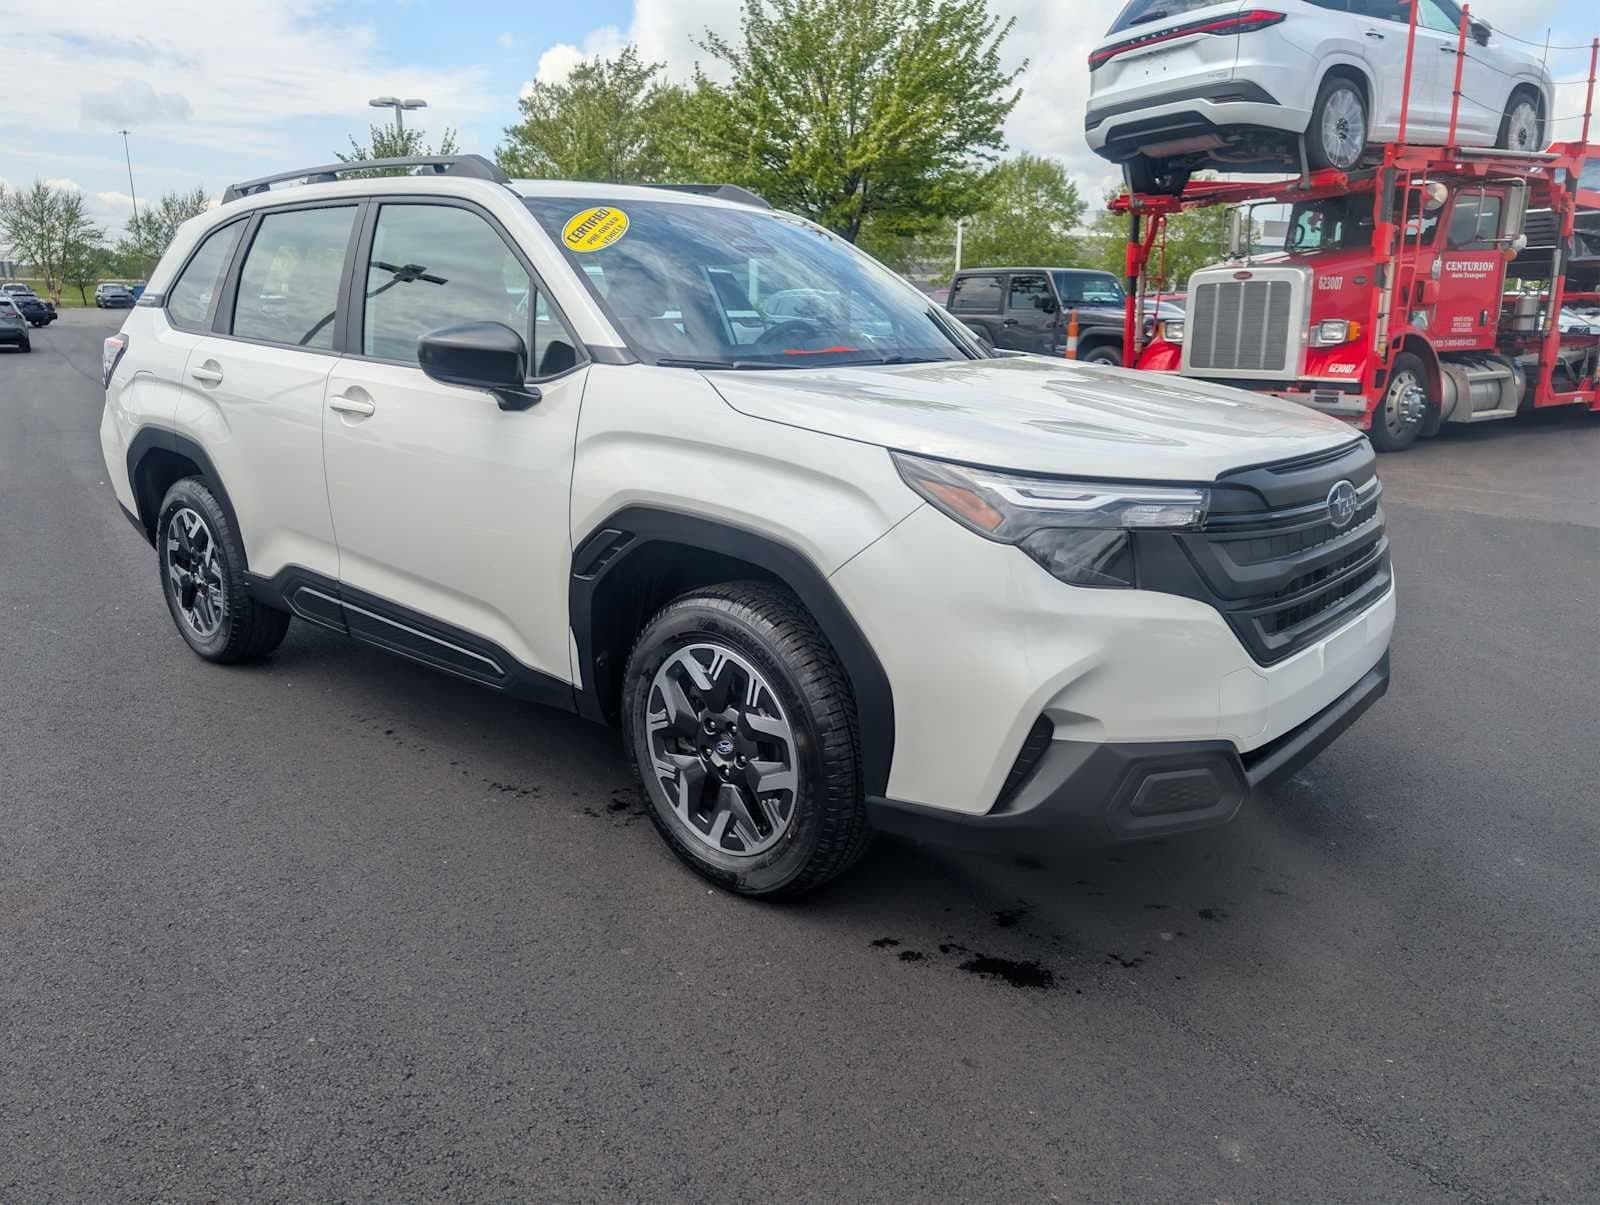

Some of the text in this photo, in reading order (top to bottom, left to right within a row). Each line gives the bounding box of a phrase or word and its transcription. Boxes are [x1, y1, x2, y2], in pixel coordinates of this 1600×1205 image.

[567, 208, 610, 243] CERTIFIED
[1446, 261, 1495, 271] CENTURION
[1319, 276, 1343, 290] 623007
[1328, 363, 1356, 373] 623007
